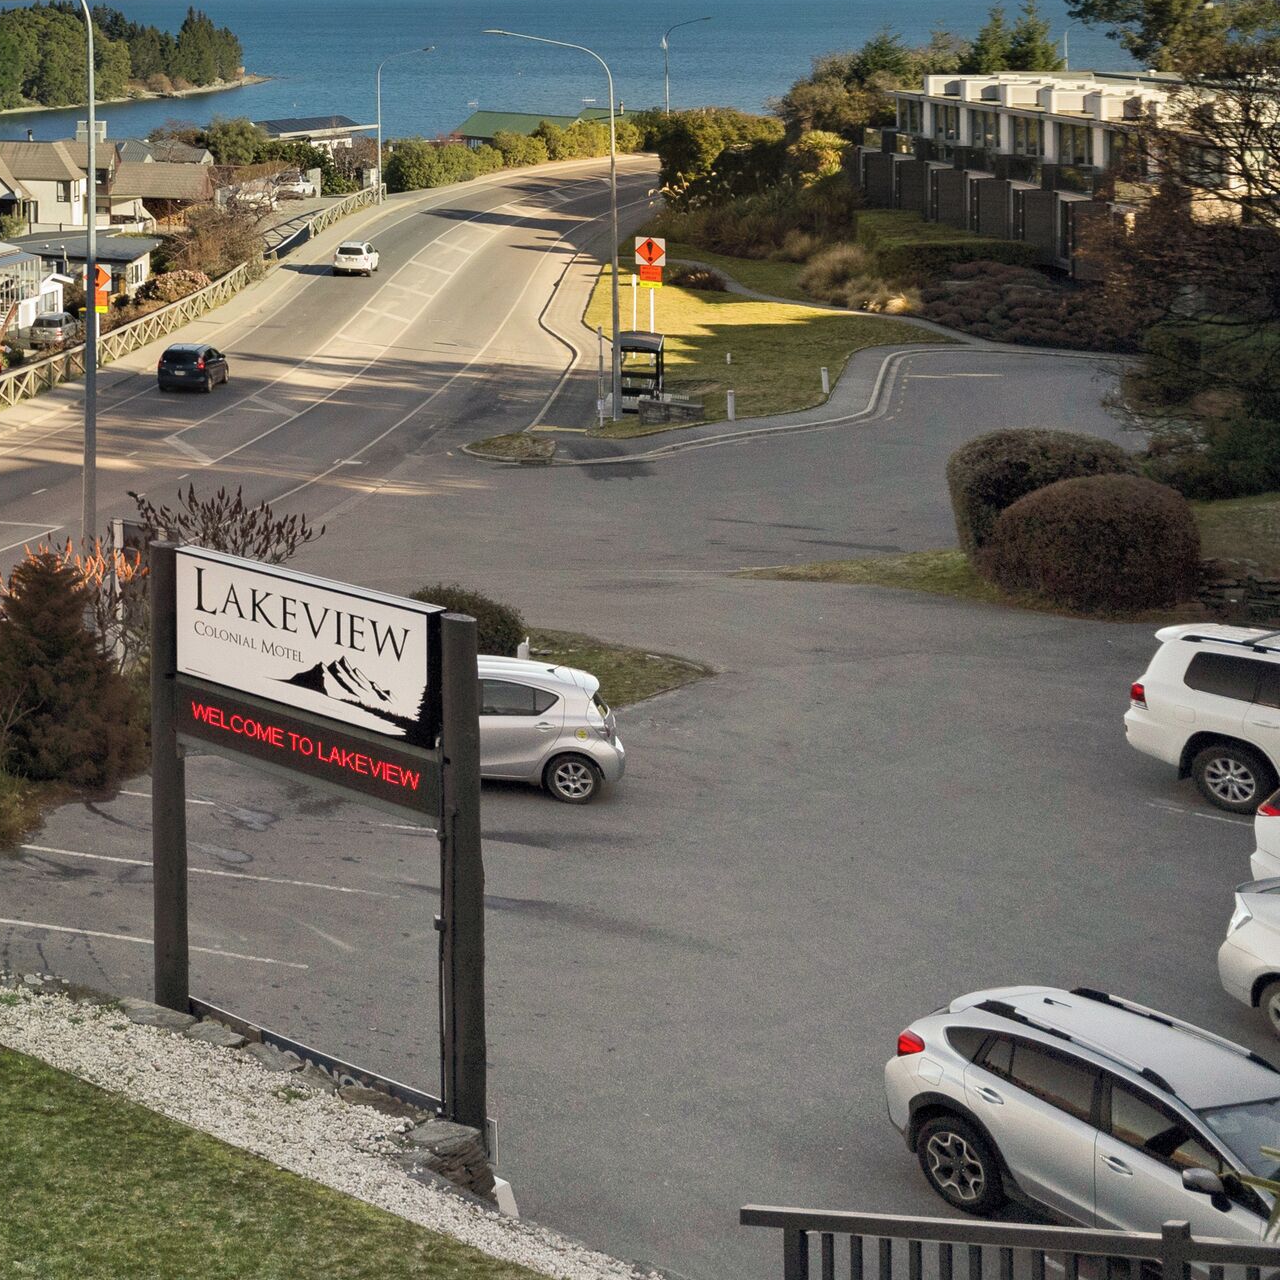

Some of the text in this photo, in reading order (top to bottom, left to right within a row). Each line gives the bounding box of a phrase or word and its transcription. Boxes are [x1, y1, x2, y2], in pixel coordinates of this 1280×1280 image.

[194, 566, 411, 662] LAKEVIEW
[194, 620, 304, 663] COLONIAL MOTEL
[192, 701, 420, 790] WELCOME TO LAKEVIEW
